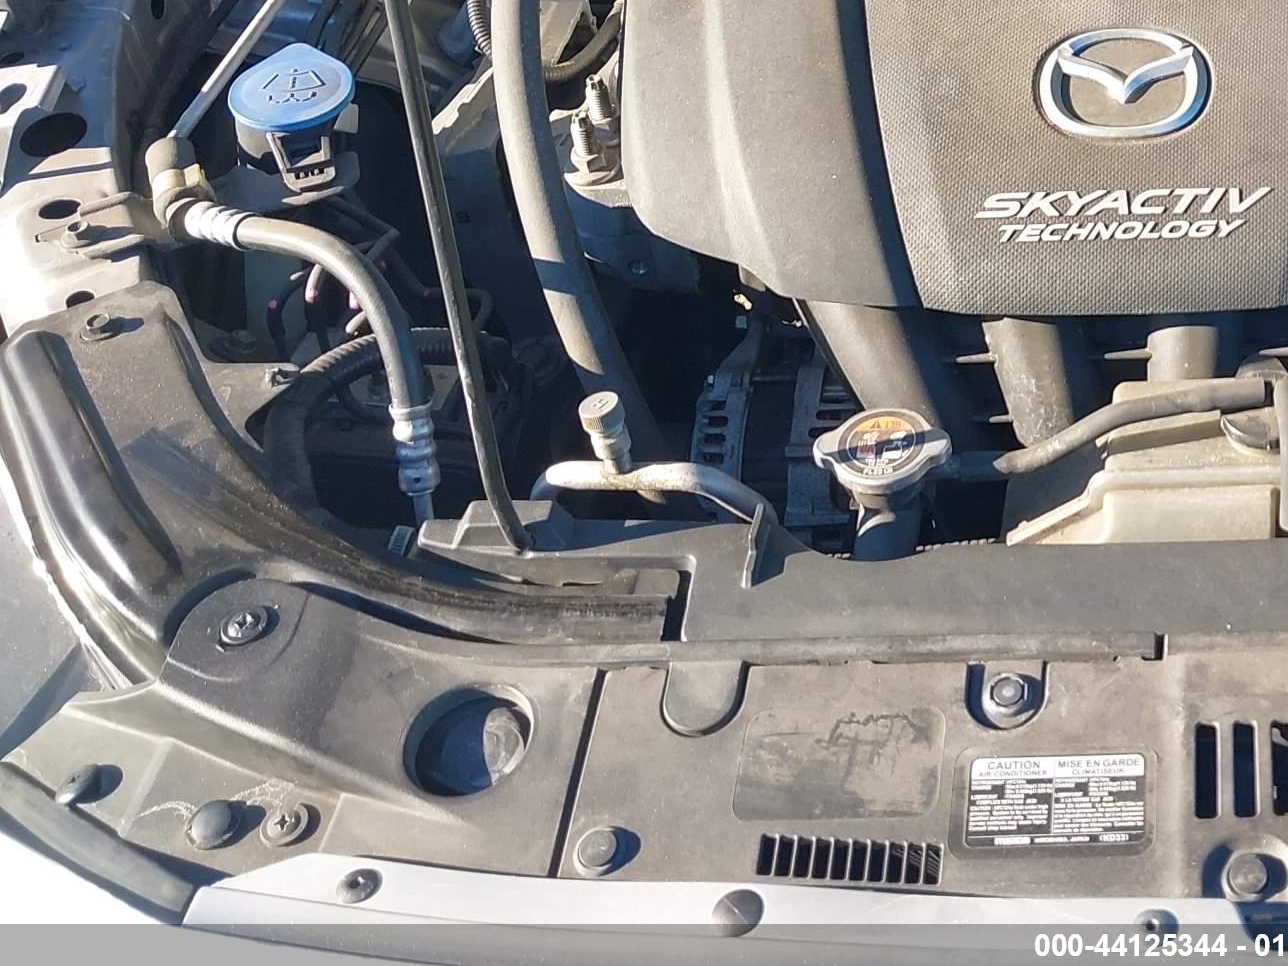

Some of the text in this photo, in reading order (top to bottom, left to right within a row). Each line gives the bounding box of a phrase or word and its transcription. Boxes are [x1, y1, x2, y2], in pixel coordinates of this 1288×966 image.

[974, 186, 1273, 219] SKYACTIV
[998, 218, 1246, 243] TECHNOLOGY
[987, 760, 1041, 770] CAUTION
[1057, 758, 1141, 769] MISE EN GARDE
[977, 769, 1048, 778] AIR CONDITIONER
[1071, 768, 1125, 777] CLIMATISEUR
